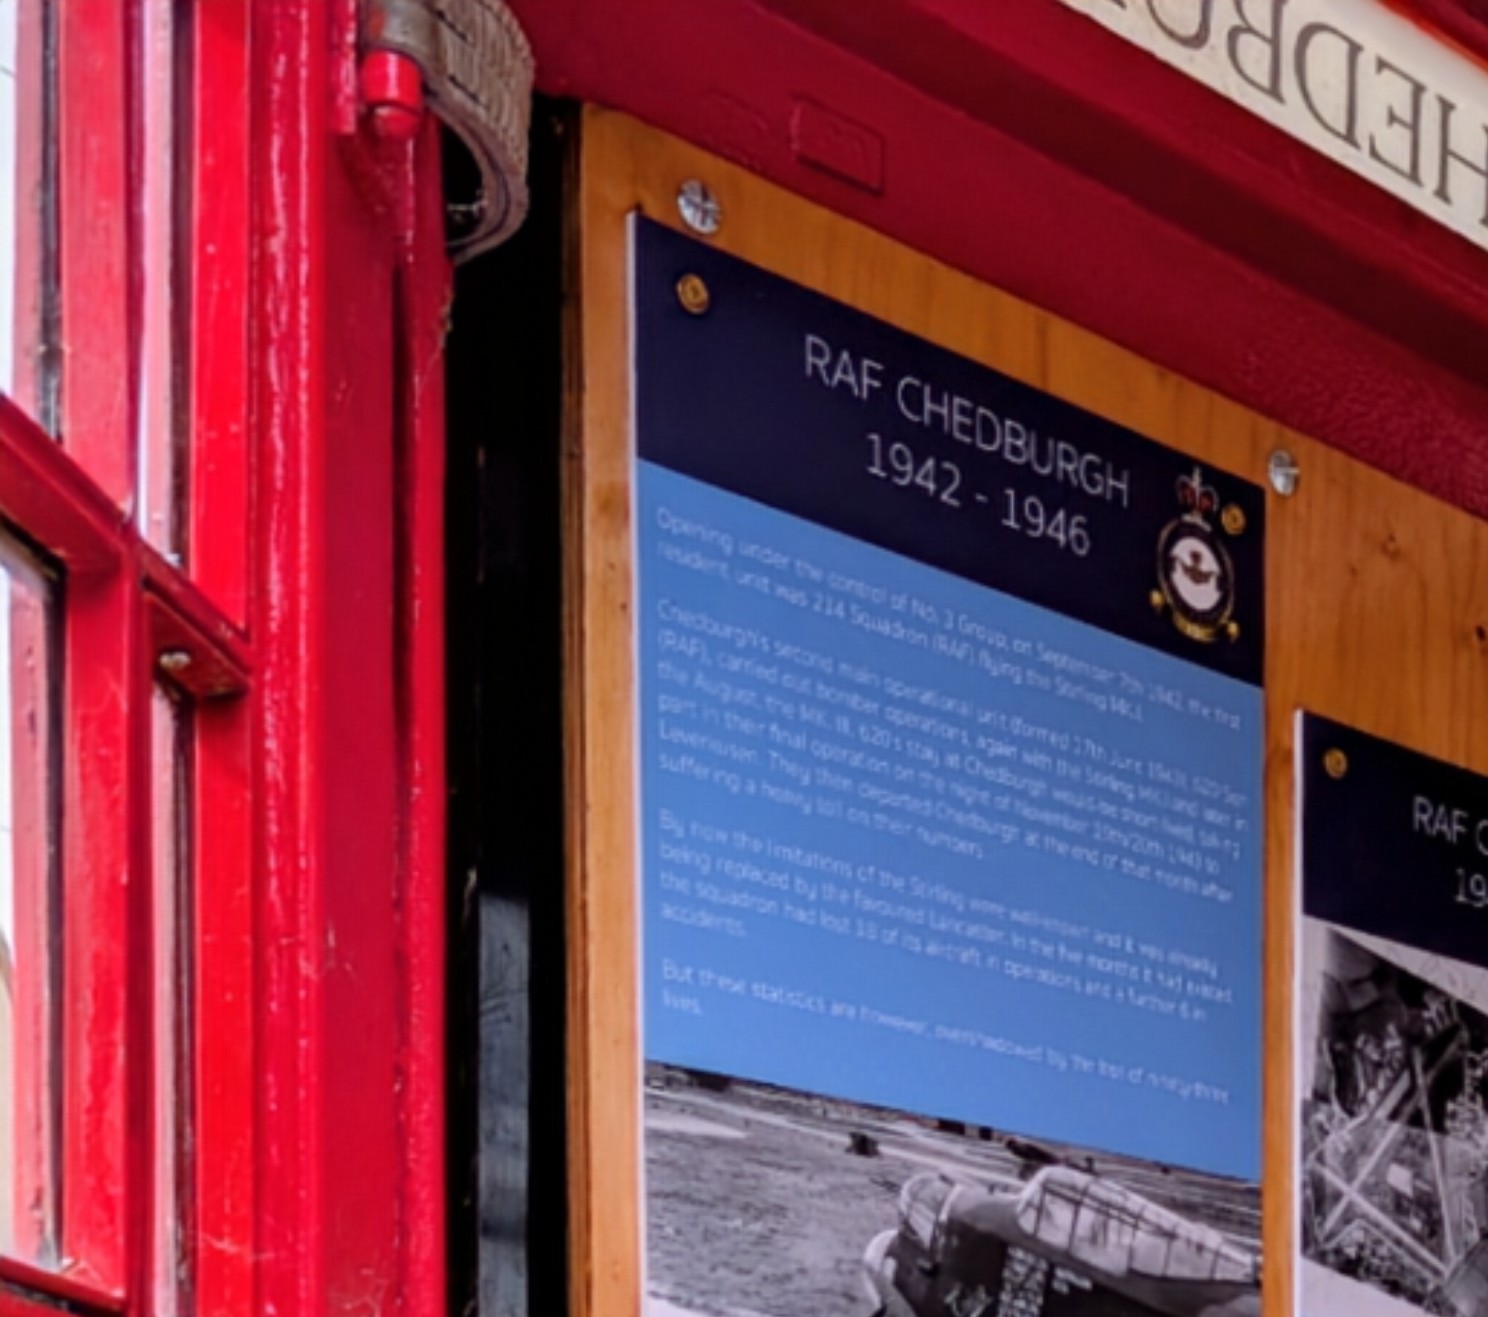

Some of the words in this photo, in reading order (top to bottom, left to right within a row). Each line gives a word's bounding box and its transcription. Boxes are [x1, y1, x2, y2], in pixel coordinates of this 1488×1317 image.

[805, 331, 884, 409] RAF
[898, 371, 1128, 510] CHEDBURGH
[865, 428, 961, 509] 1942
[1001, 483, 1090, 560] 1946
[656, 506, 732, 556] Opening
[738, 535, 789, 572] under
[795, 556, 822, 584] the
[827, 567, 885, 607] control
[689, 820, 727, 845] now
[732, 827, 763, 855] the
[767, 837, 853, 879] limitations
[879, 867, 905, 893] the
[908, 875, 965, 912] Stirling
[1414, 794, 1467, 849] RAF
[659, 837, 712, 874] being
[716, 852, 790, 895] replaced
[822, 880, 849, 906] the
[853, 888, 925, 926] favoured
[662, 958, 695, 985] But
[698, 966, 746, 996] these
[750, 978, 826, 1014] statistics
[830, 1001, 856, 1021] are
